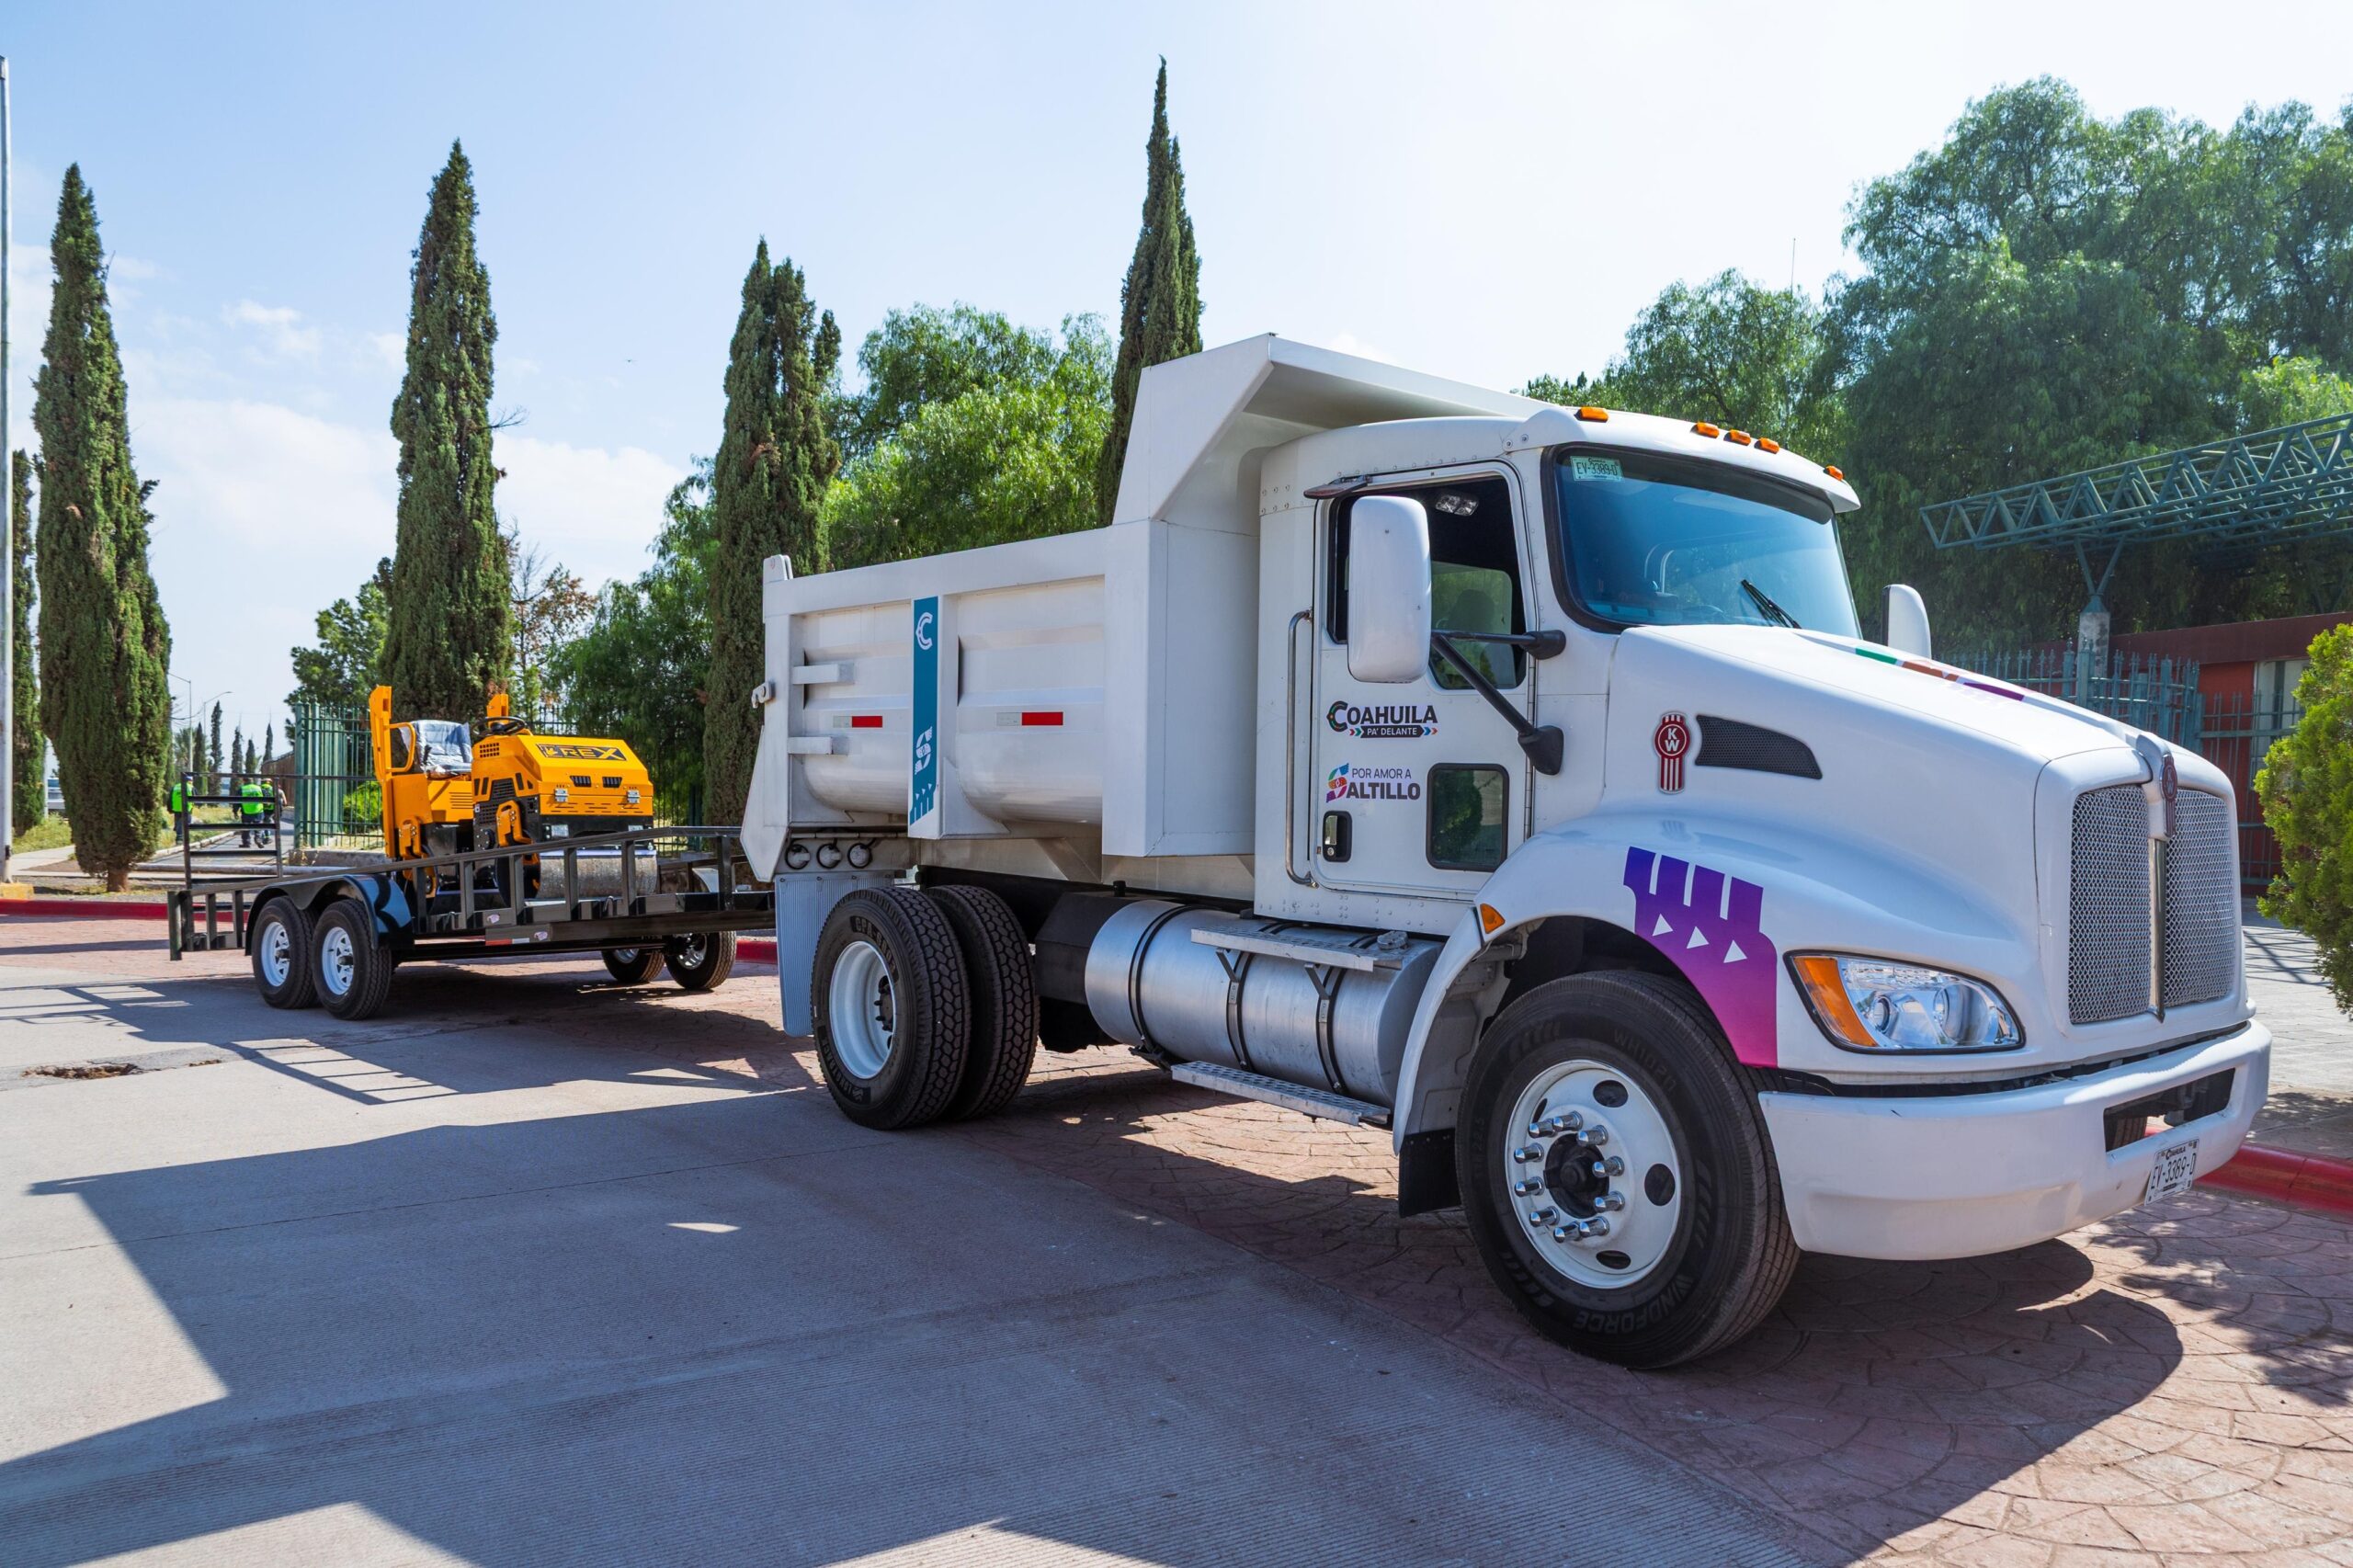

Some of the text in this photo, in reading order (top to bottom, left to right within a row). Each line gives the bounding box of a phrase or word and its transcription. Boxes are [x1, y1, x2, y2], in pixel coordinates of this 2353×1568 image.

[1576, 461, 1618, 476] EV-3389-D
[1326, 700, 1438, 733] COAHUILA
[1381, 726, 1417, 736] DELANTE
[1351, 767, 1412, 779] POR AMOR A
[2151, 1153, 2197, 1190] EV-3389-D
